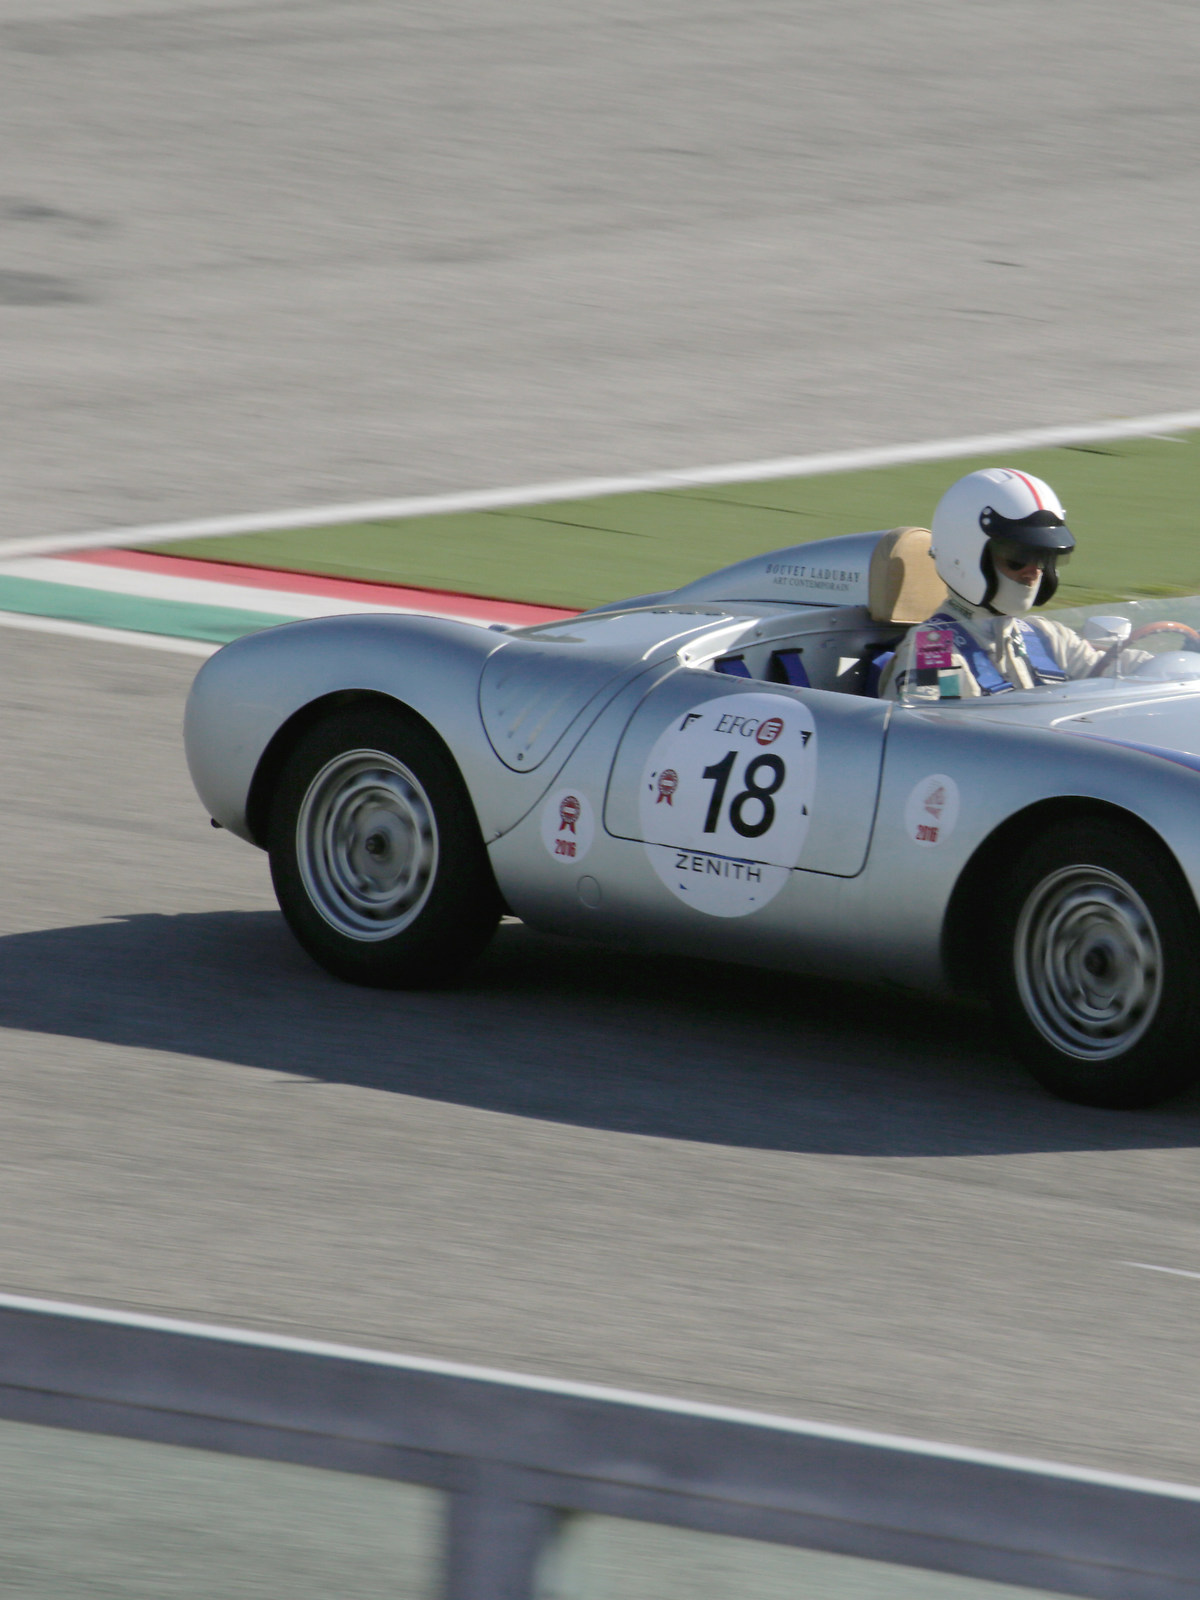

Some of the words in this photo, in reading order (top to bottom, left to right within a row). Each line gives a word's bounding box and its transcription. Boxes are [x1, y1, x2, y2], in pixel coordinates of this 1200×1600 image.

[766, 563, 806, 577] BOUVET
[811, 567, 861, 583] LADUBAY
[714, 713, 760, 738] EFG
[702, 751, 786, 838] 18
[916, 824, 939, 842] 2016
[555, 839, 577, 857] 2016
[675, 853, 761, 883] ZENITH
